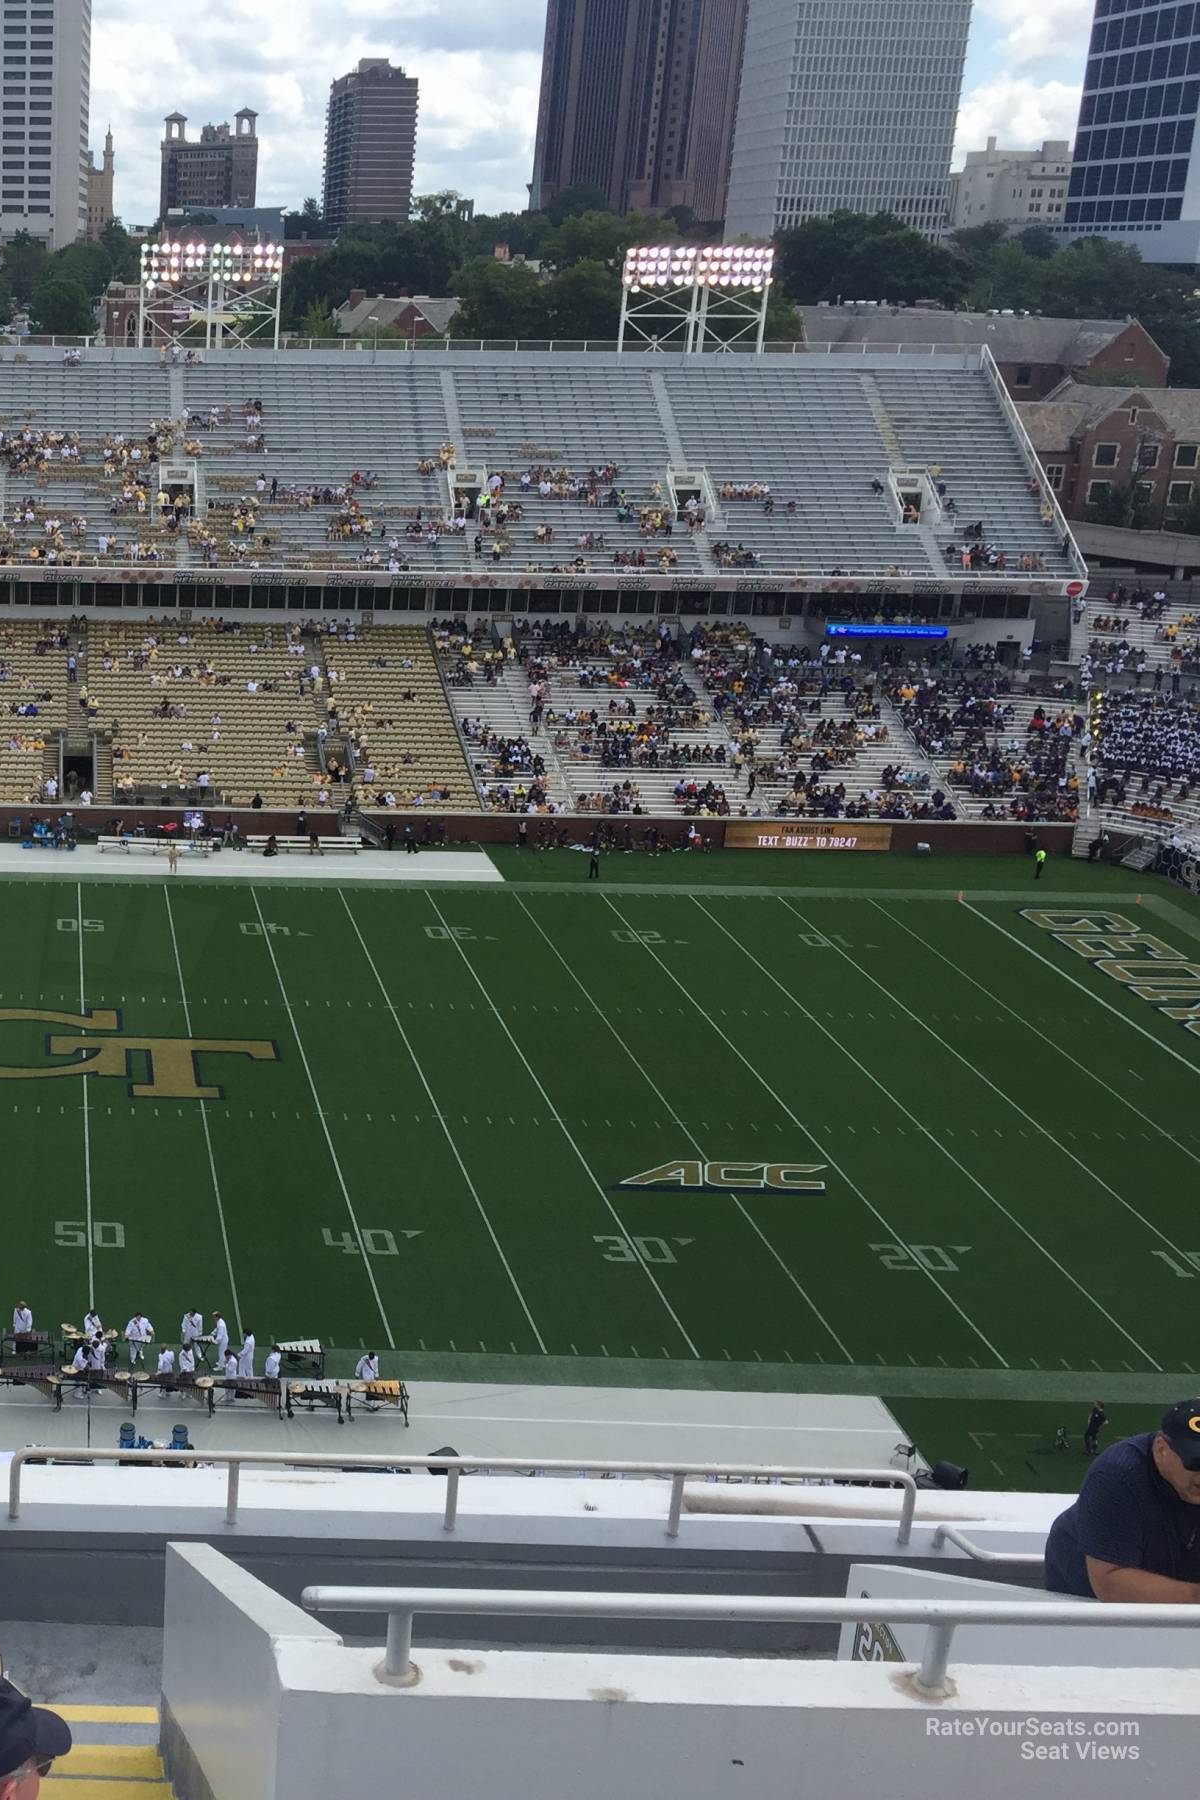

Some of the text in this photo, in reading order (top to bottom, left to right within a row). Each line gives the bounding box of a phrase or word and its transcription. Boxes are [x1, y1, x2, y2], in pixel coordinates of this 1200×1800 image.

[757, 836, 857, 848] TEXT "BUZZ" TO 78247
[56, 918, 105, 932] 50
[240, 922, 290, 937] 40
[424, 926, 478, 940] 30
[619, 1160, 828, 1190] ACC
[54, 1221, 125, 1248] 50
[321, 1227, 399, 1255] 40
[592, 1234, 678, 1263] 30
[867, 1243, 960, 1272] 20
